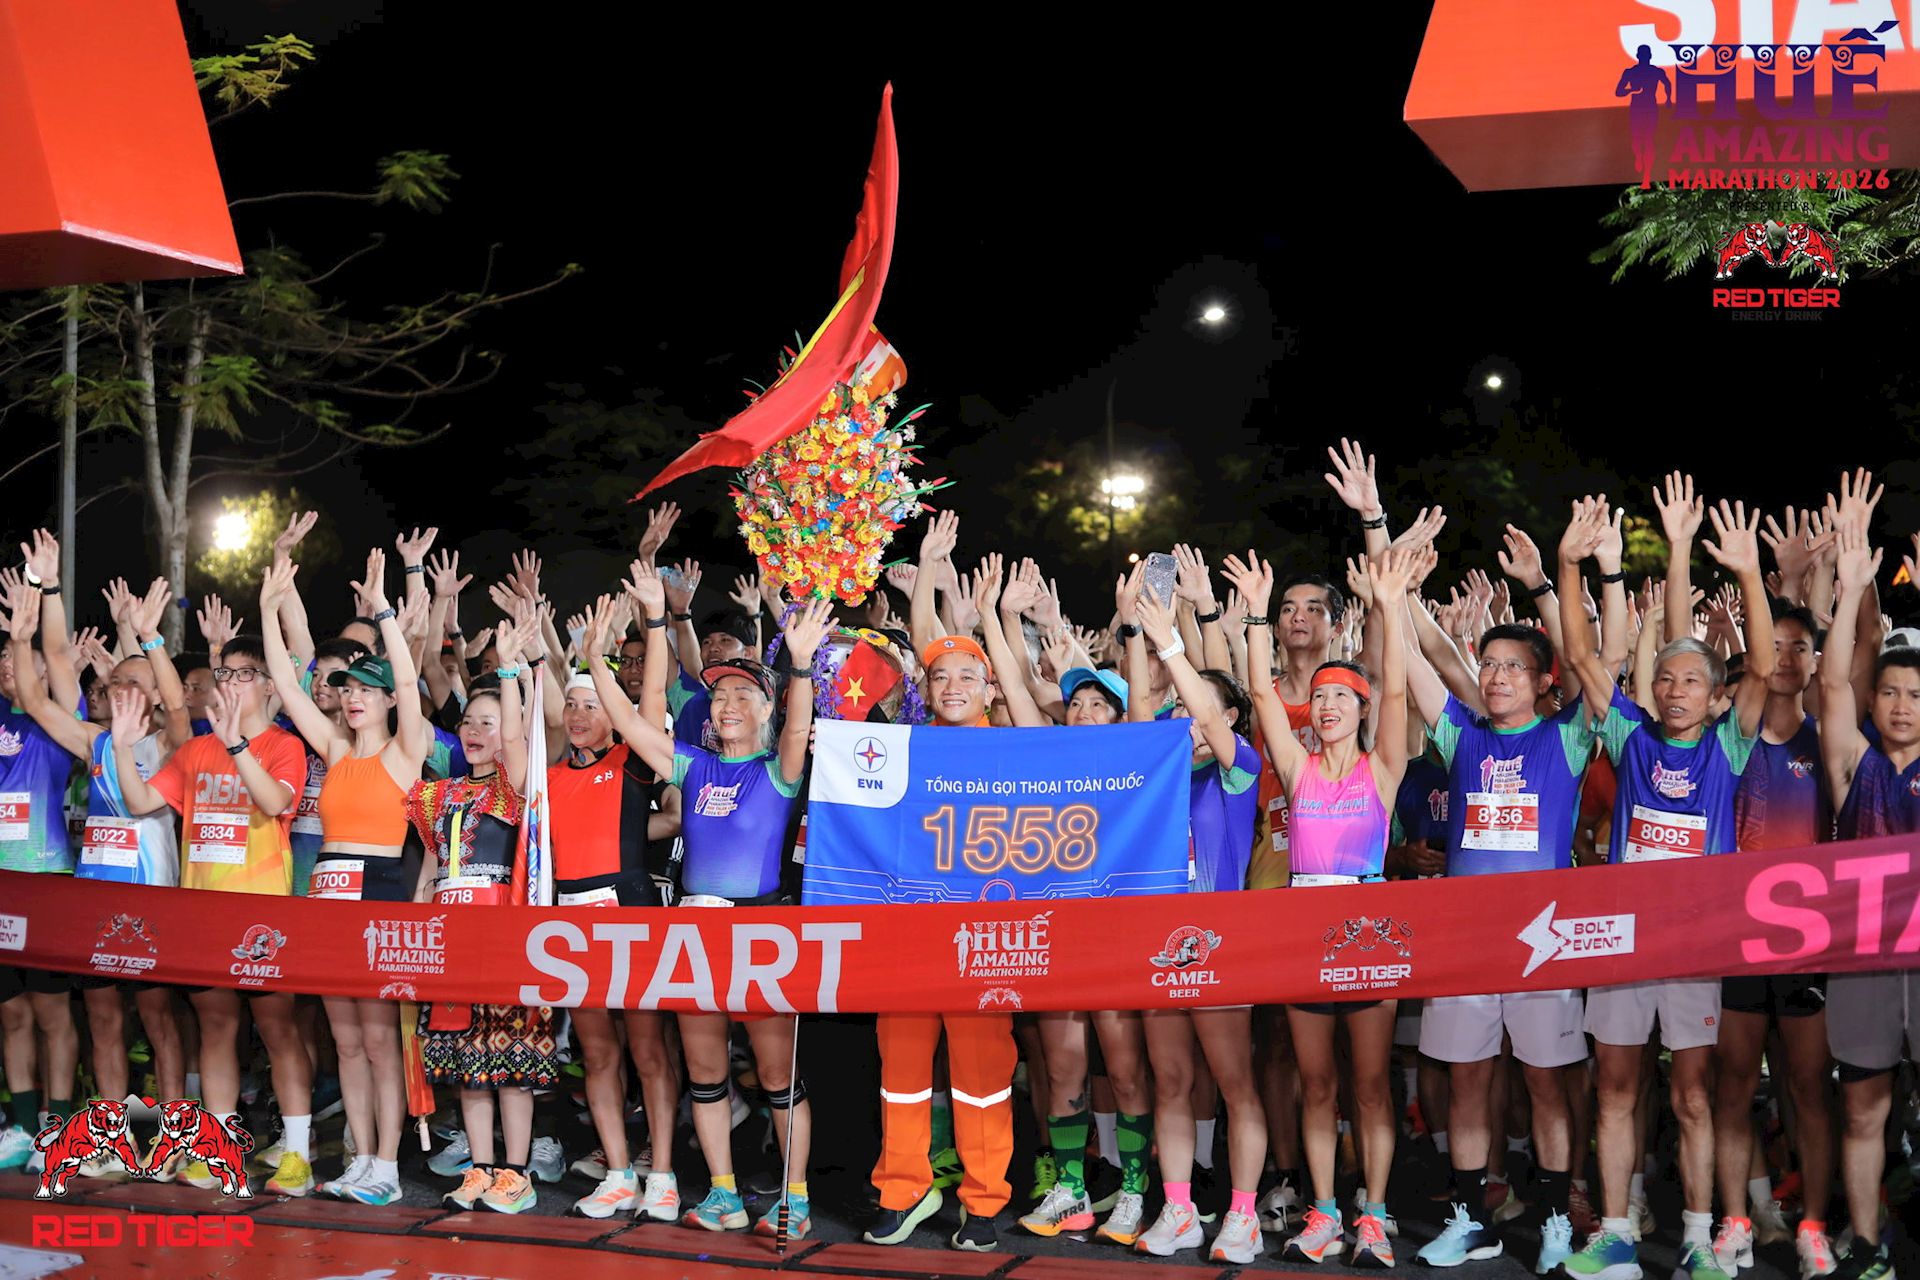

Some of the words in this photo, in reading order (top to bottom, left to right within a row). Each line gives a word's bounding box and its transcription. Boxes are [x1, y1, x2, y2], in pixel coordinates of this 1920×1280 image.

[1618, 0, 1920, 67] STA
[857, 778, 883, 790] EVN
[925, 776, 962, 793] TỔNG
[966, 778, 988, 794] ĐÀI
[992, 781, 1016, 797] GỌI
[1020, 780, 1061, 797] THOẠI
[1065, 777, 1101, 793] TOÀN
[1105, 771, 1145, 791] QUỐC
[1477, 807, 1523, 824] 8256
[92, 828, 127, 844] 8022
[200, 825, 235, 840] 8834
[922, 804, 1099, 874] 1558
[1641, 824, 1690, 847] 8095
[315, 873, 350, 889] 8700
[440, 889, 474, 904] 8718
[1740, 852, 1920, 964] ST
[0, 919, 14, 930] LT
[378, 914, 448, 950] HUẾ
[972, 910, 1054, 951] HUẾ
[1574, 920, 1615, 935] BOLT
[1573, 936, 1622, 951] EVENT
[90, 952, 118, 966] RED
[118, 954, 157, 970] TIGER
[378, 950, 445, 965] AMAZING
[971, 951, 1050, 967] AMAZING
[230, 962, 283, 979] CAMEL
[378, 963, 423, 974] MARATHON
[424, 964, 445, 974] 2026
[519, 920, 862, 1013] START
[969, 967, 1023, 977] MARATHON
[1024, 967, 1048, 976] 2026
[1320, 967, 1358, 983] RED
[1359, 963, 1411, 980] TIGER
[239, 977, 264, 986] BEER
[1151, 970, 1220, 987] CAMEL
[1333, 982, 1369, 992] ENERGY
[1371, 980, 1398, 989] DRINK
[1169, 988, 1200, 999] BEER
